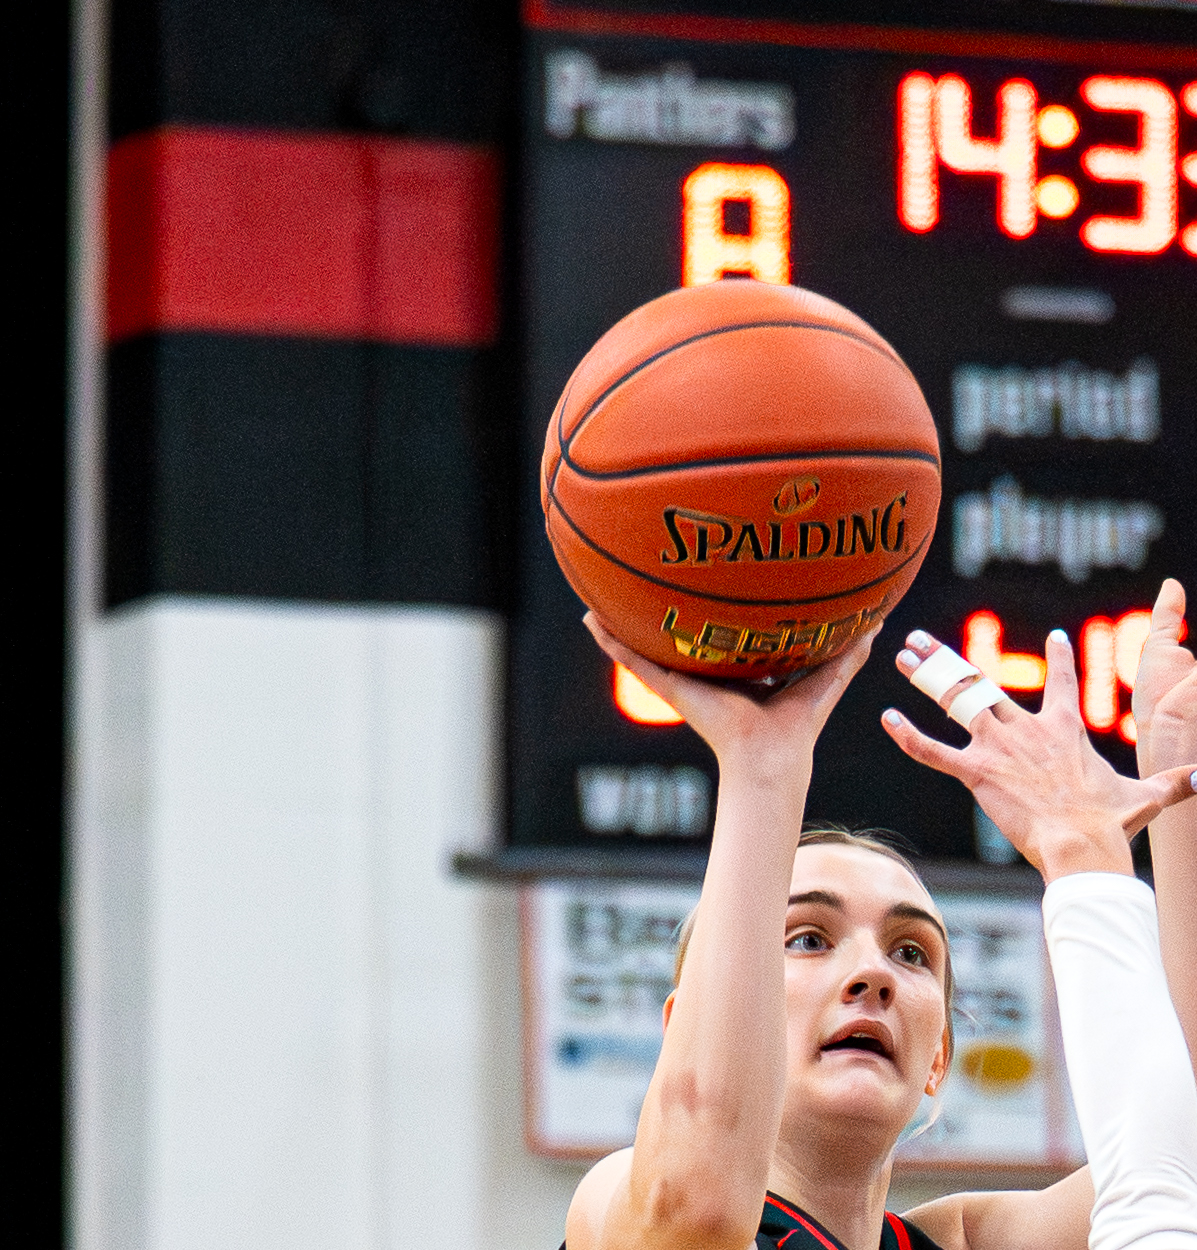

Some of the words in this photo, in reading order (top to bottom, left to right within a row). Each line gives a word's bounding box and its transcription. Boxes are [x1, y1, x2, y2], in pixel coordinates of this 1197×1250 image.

[952, 357, 1160, 452] period
[660, 490, 909, 566] SPALDING
[953, 475, 1164, 582] player
